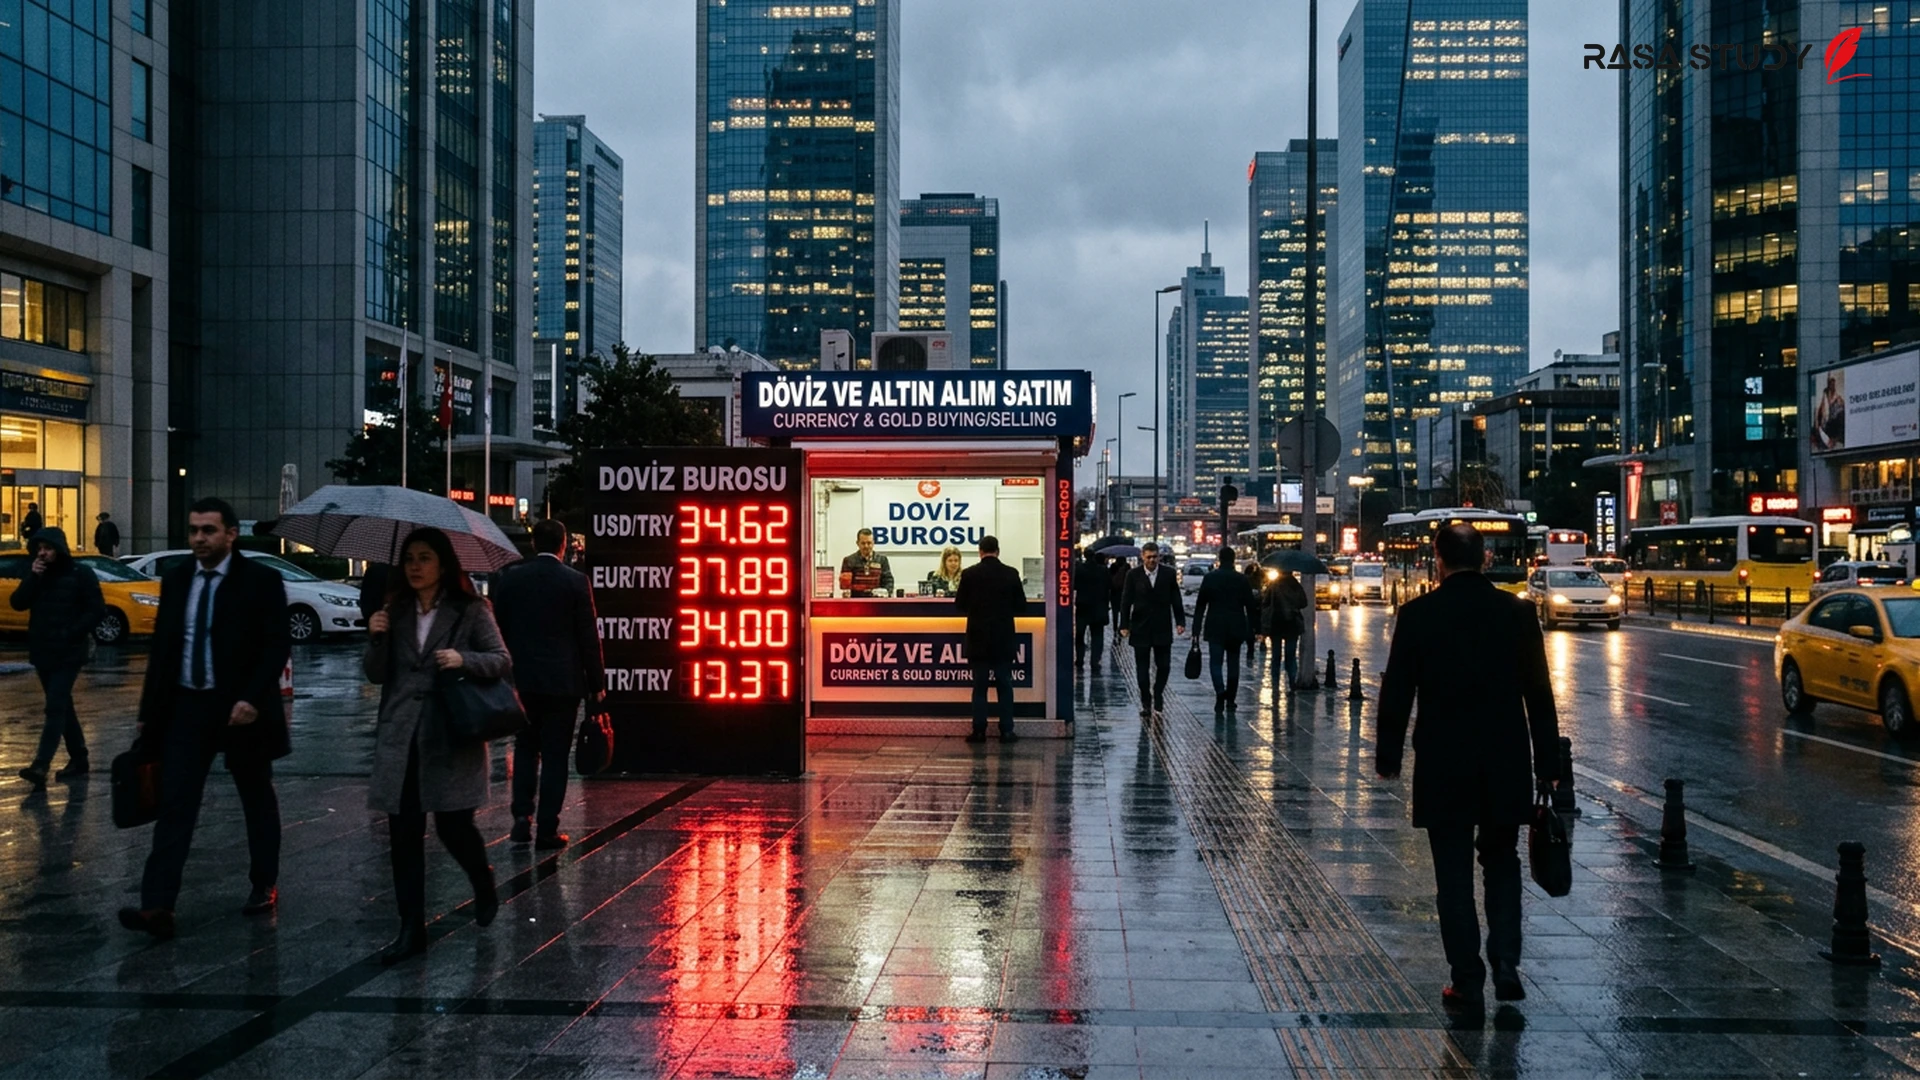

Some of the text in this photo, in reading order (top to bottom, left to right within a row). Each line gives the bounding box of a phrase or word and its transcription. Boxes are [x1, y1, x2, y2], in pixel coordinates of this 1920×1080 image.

[758, 375, 1072, 408] DÖVİZ VE ALTIN ALIM SATIM
[773, 411, 1057, 429] CURRENCY & GOLD BUYING/SELLING
[599, 460, 787, 492] DOVİZ BUROSU
[593, 505, 788, 544] USD/TRY 34.62
[888, 498, 970, 521] DOVİZ
[873, 526, 985, 546] BUROSU
[592, 566, 674, 589] EUR/TRY
[680, 557, 788, 595] 37.89
[680, 608, 788, 647] 34.00
[830, 638, 897, 664] DÖVİZ
[903, 643, 933, 664] VE
